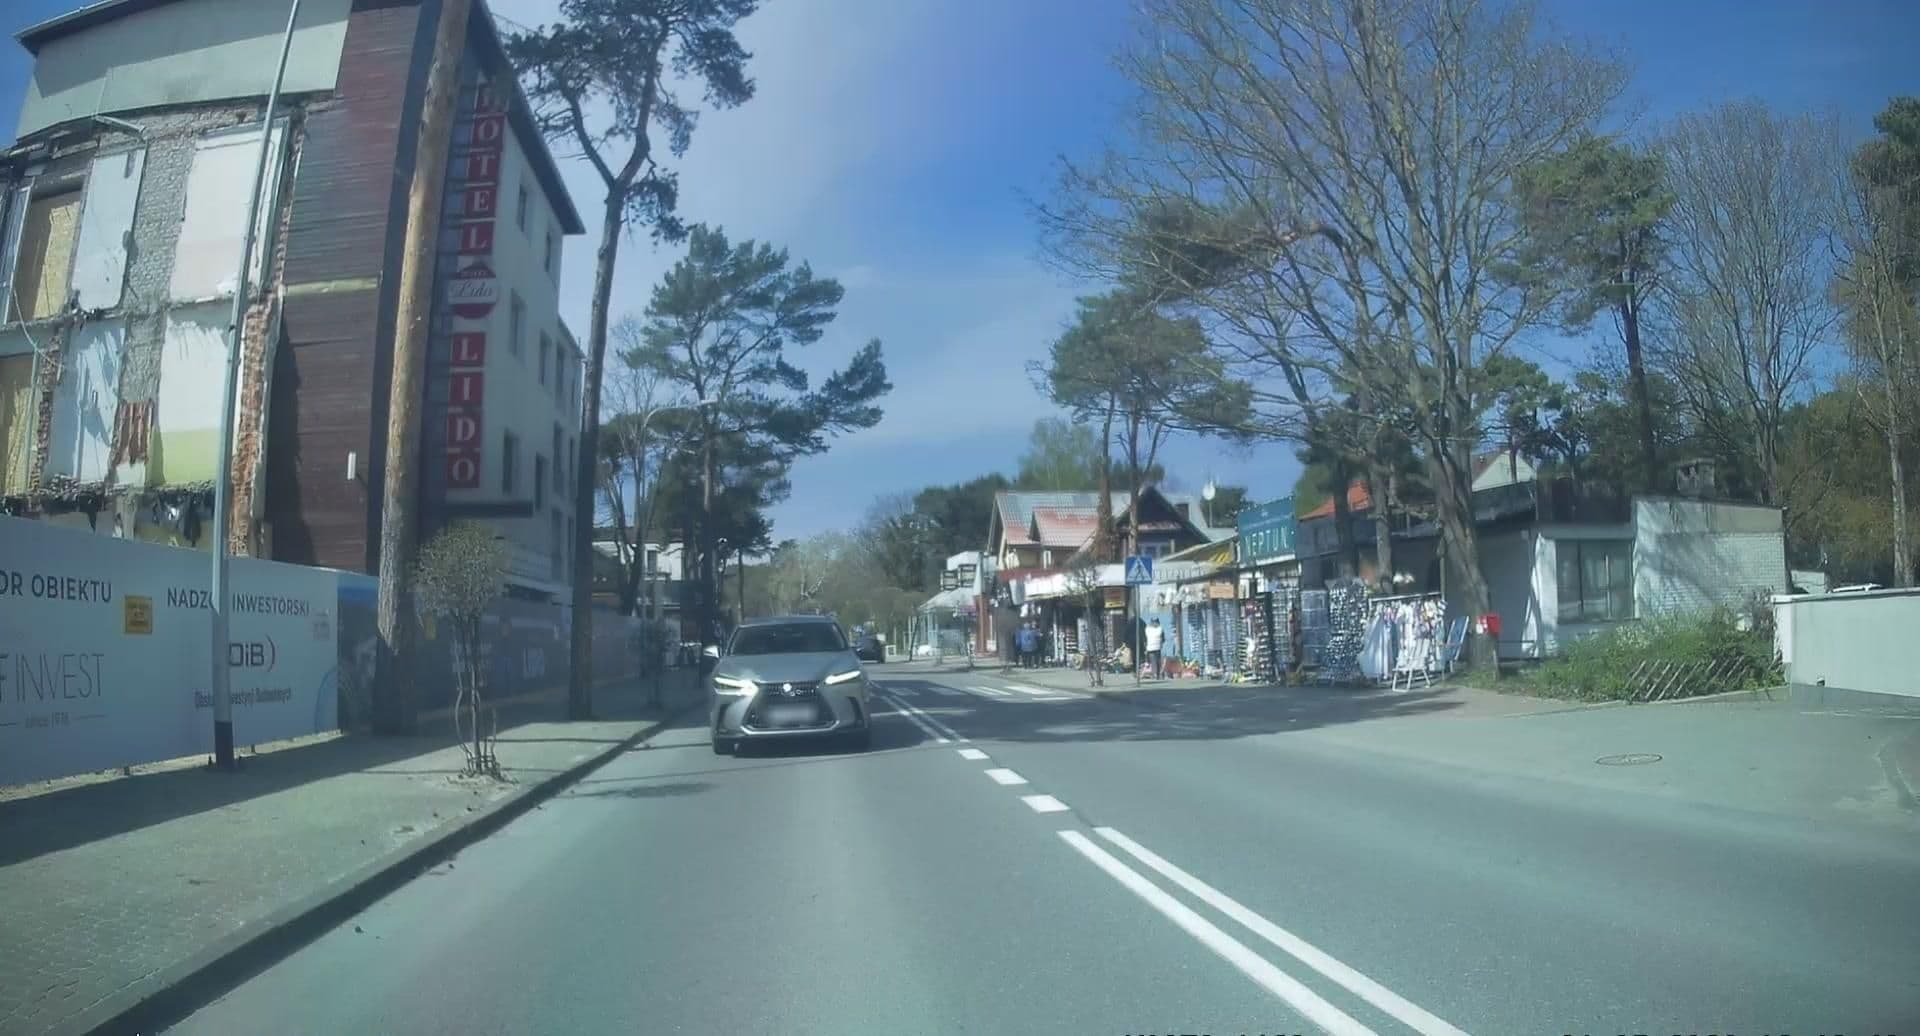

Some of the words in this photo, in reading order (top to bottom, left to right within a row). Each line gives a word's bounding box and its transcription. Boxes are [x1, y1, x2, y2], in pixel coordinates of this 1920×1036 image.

[452, 337, 479, 483] LIDO
[1243, 525, 1289, 557] NEPTUN
[32, 573, 112, 604] OBIEKTU
[232, 593, 310, 617] INWESTORSKI
[15, 653, 105, 704] INVEST
